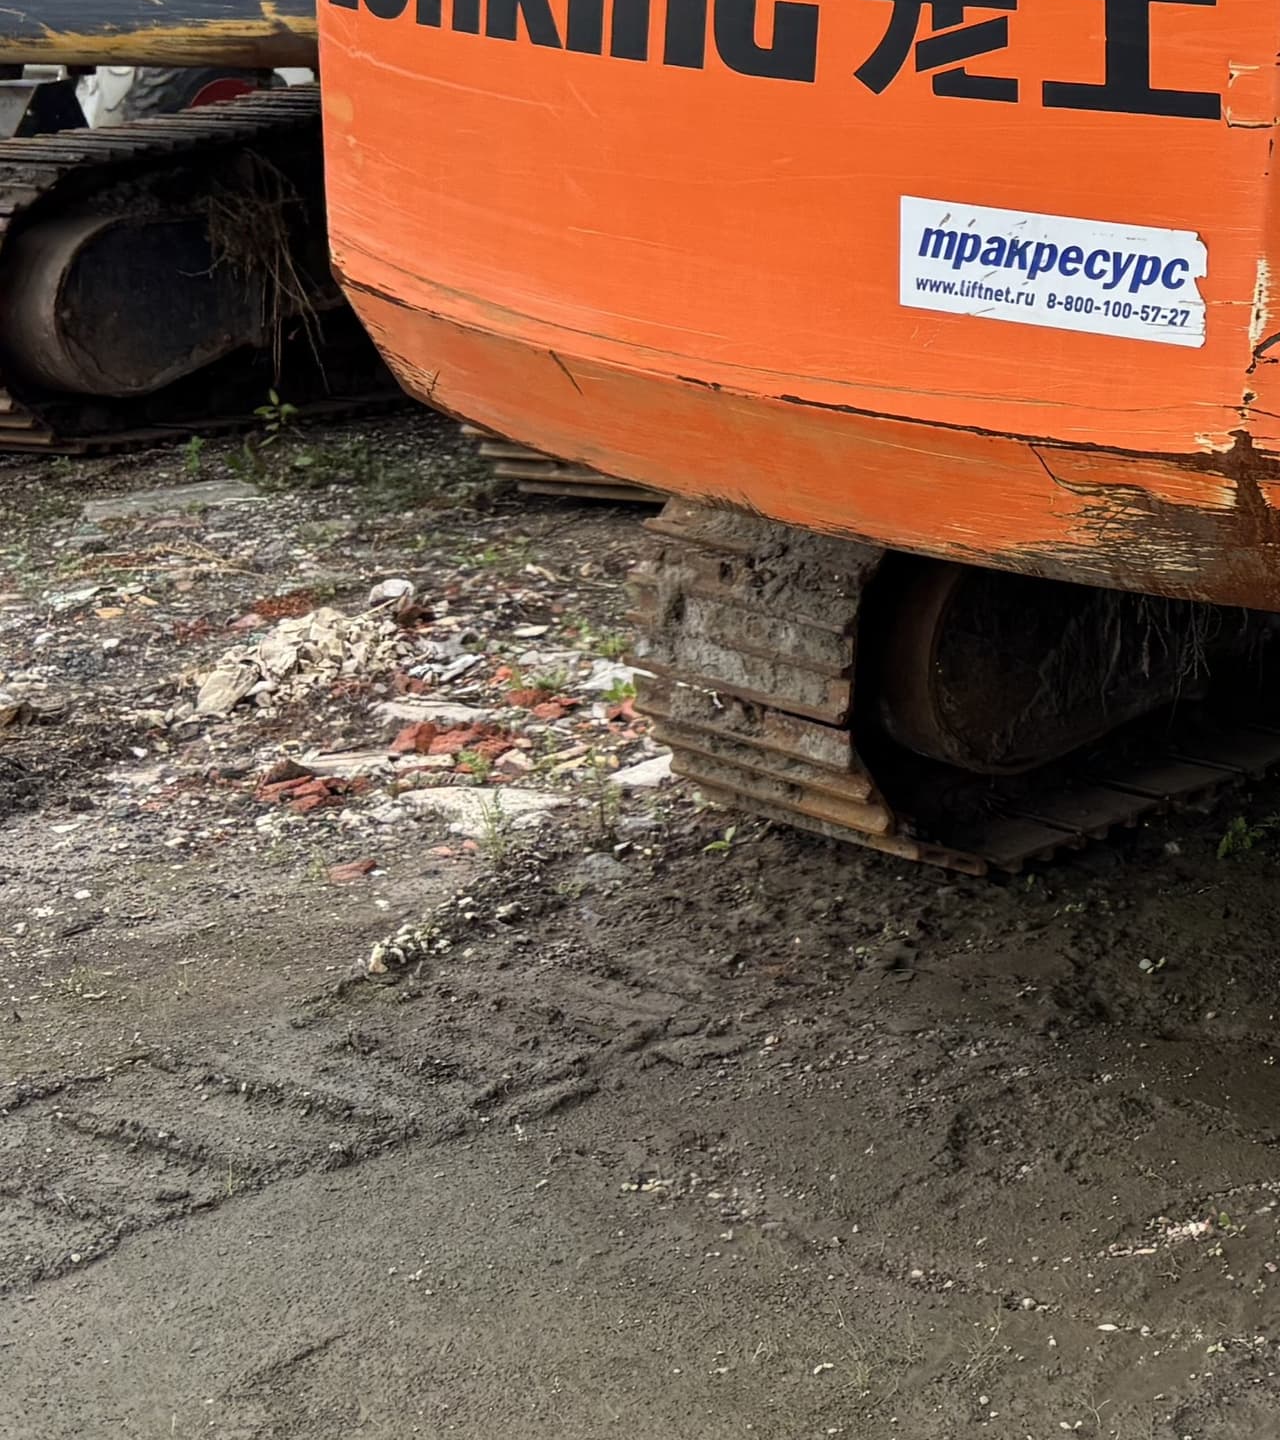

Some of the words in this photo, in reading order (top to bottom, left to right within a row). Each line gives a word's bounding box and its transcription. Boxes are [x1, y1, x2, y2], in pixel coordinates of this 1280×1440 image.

[918, 227, 1189, 293] тракресурс
[916, 277, 1035, 306] www.liftnet.ru
[1047, 293, 1190, 327] 8-800-100-57-27
